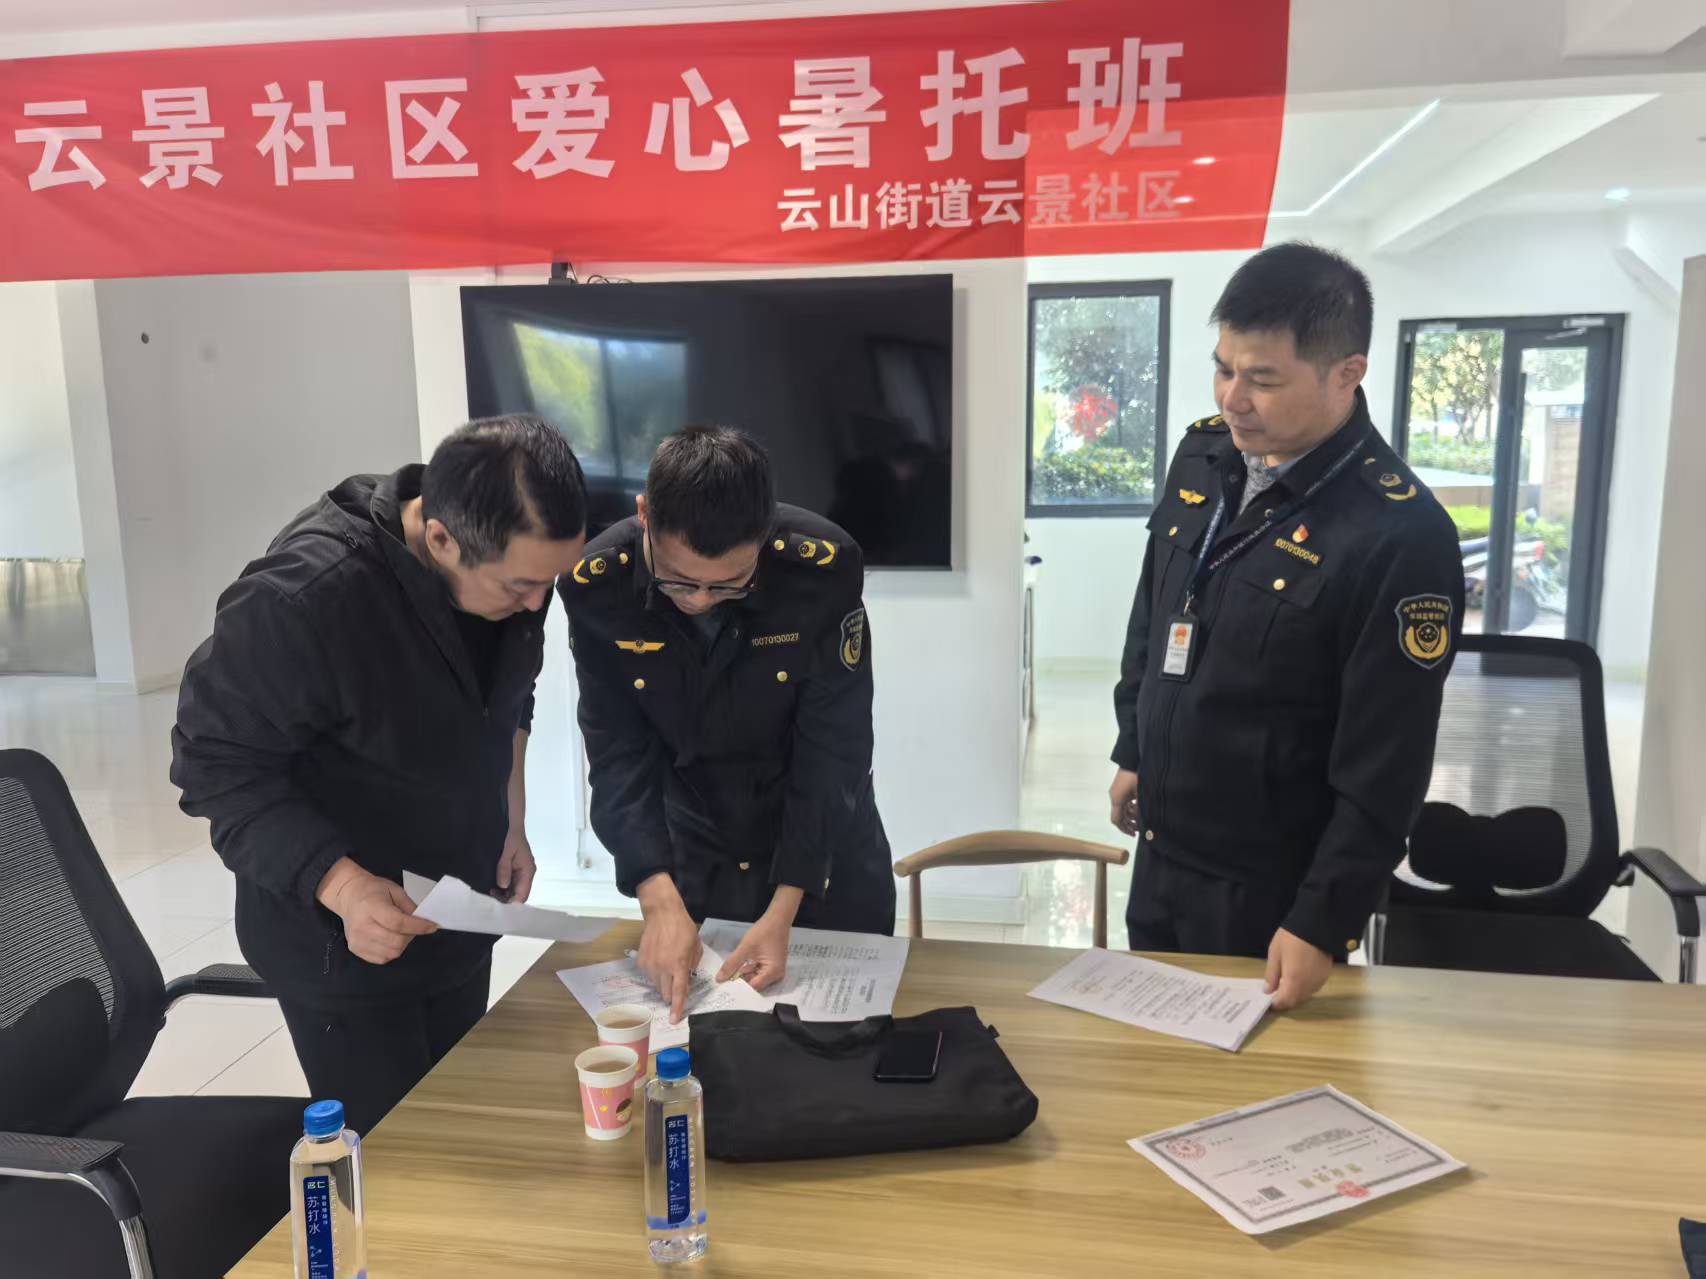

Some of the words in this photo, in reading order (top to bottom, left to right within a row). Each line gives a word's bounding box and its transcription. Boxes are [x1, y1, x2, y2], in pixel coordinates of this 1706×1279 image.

[14, 38, 1184, 192] 云景社区爱心暑托班
[777, 170, 1182, 232] 云山街道云景社区
[668, 1134, 680, 1170] 苏打水
[307, 1196, 321, 1235] 苏打水
